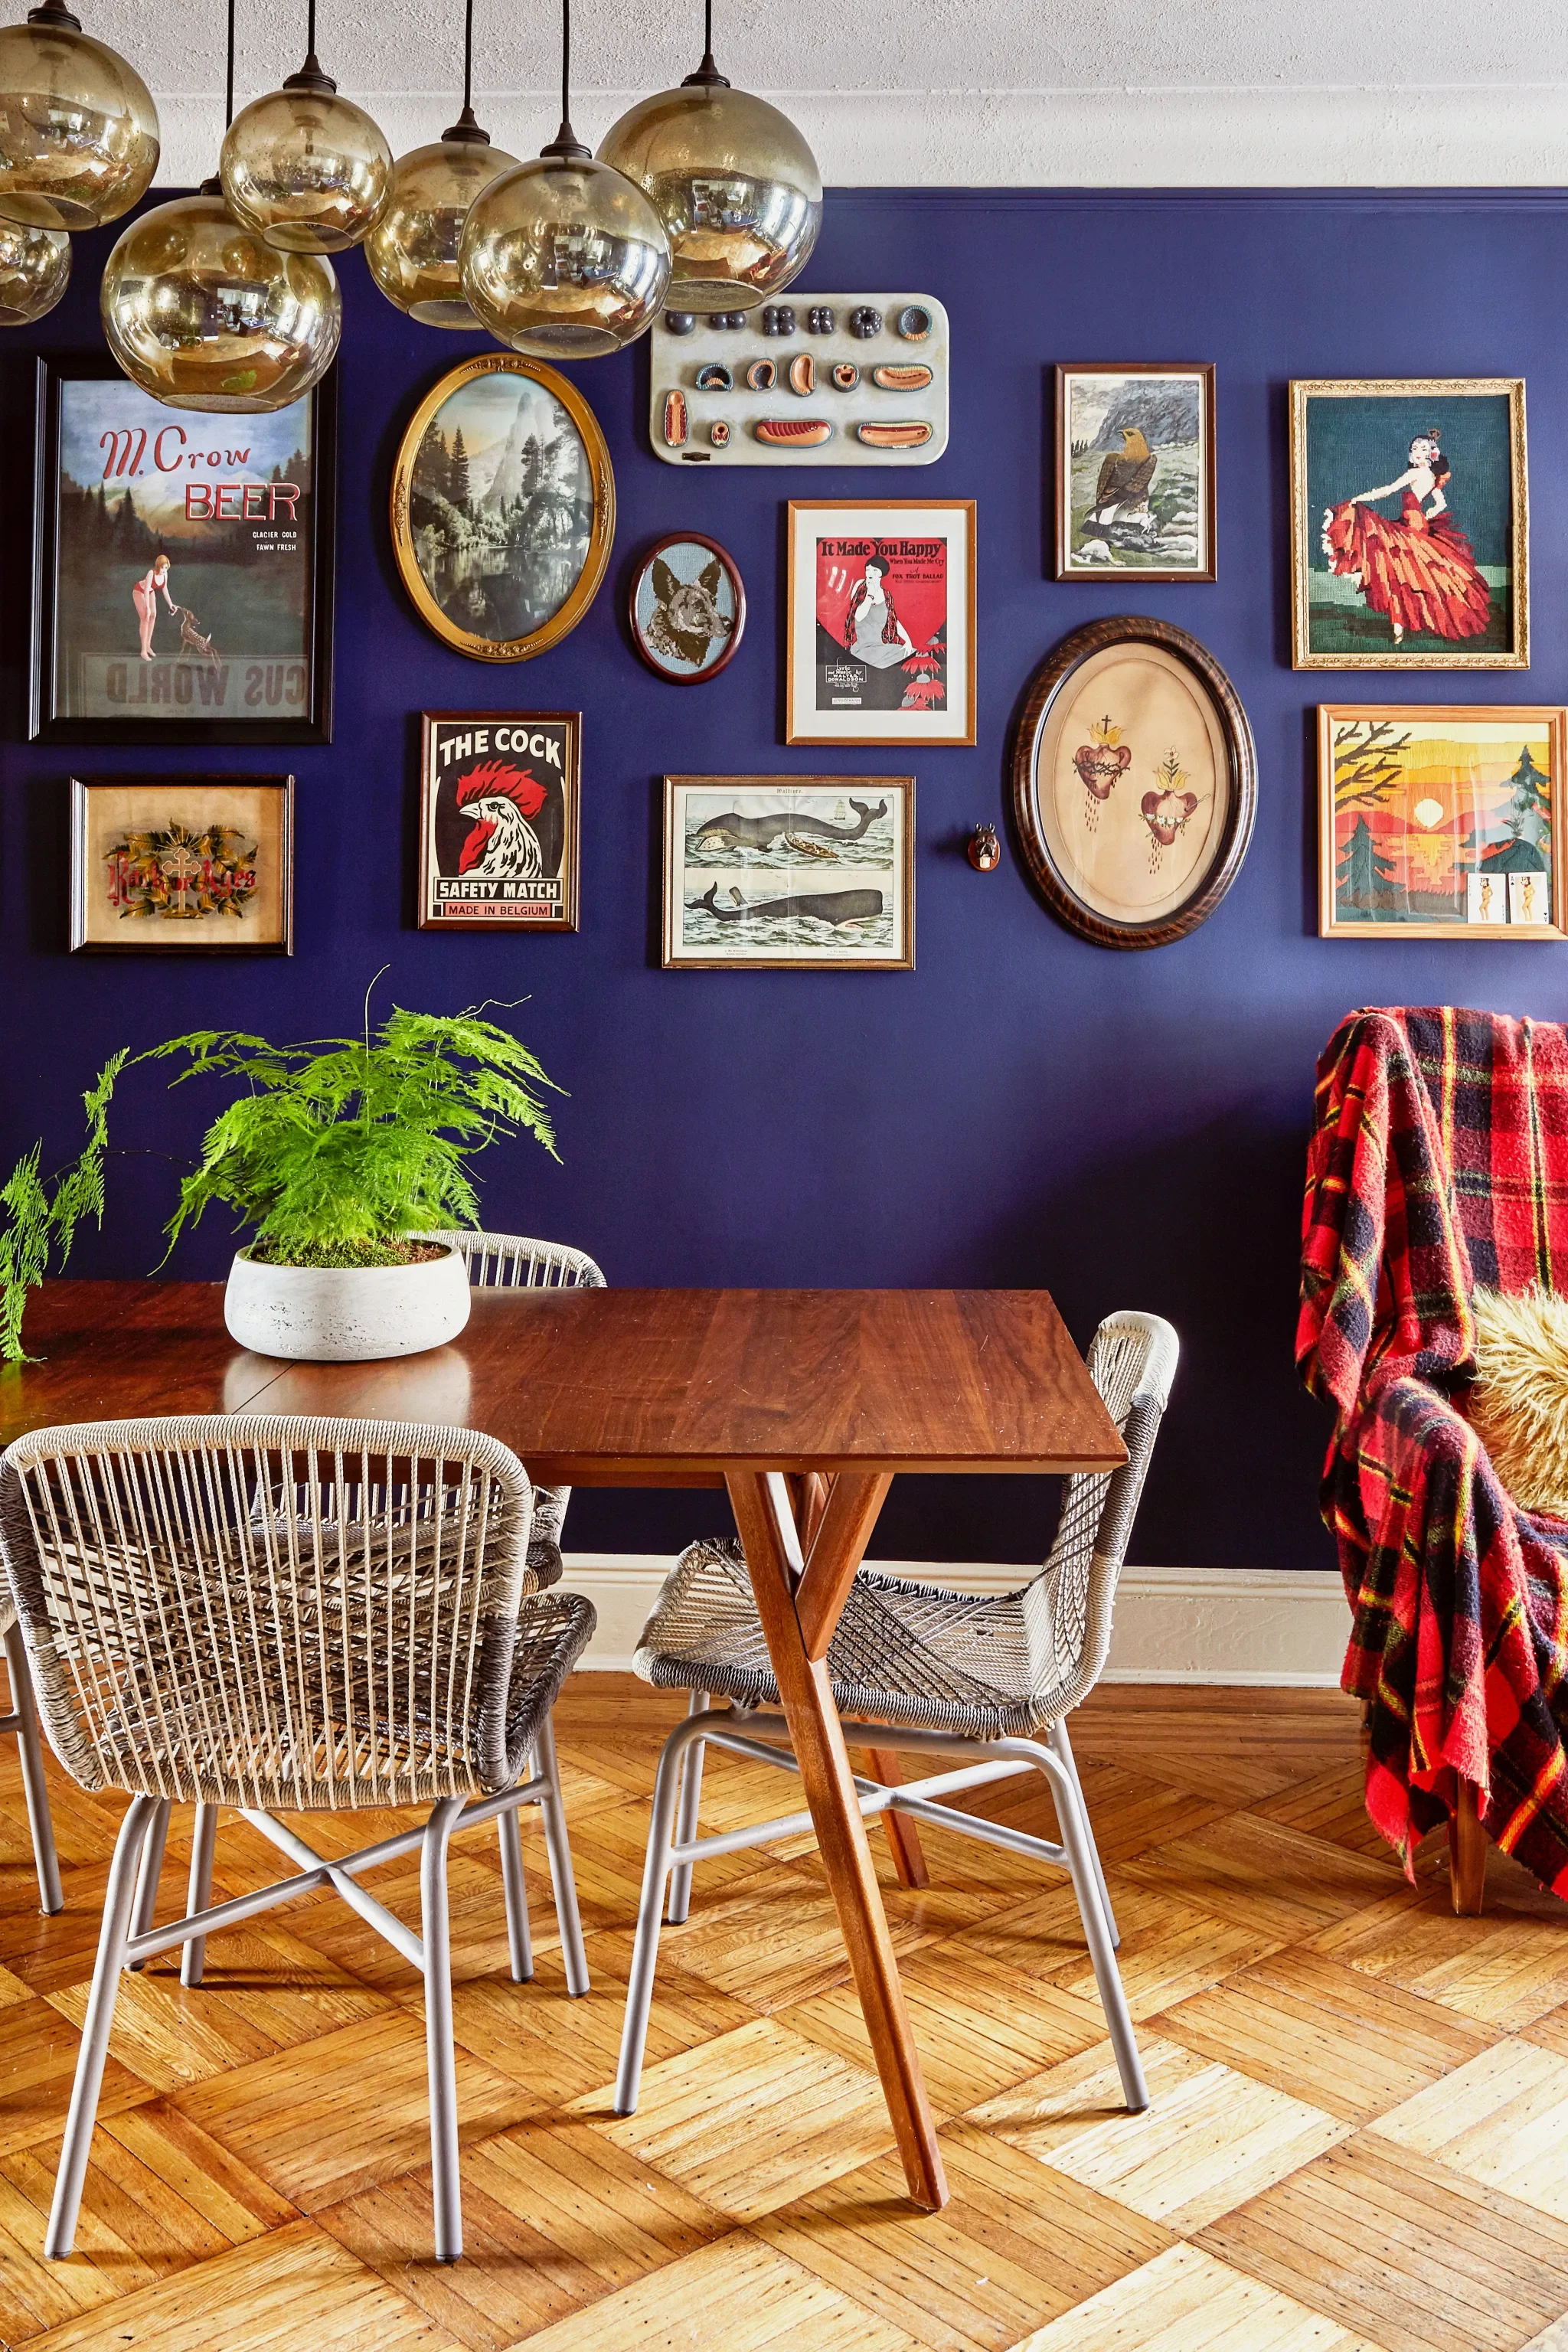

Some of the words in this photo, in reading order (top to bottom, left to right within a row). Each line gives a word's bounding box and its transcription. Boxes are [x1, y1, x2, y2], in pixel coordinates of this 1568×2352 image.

[154, 425, 251, 472] Crow
[185, 482, 301, 521] BEER
[822, 541, 834, 556] It
[837, 541, 871, 556] Made
[871, 541, 898, 556] You
[899, 541, 942, 558] Happy
[935, 558, 945, 567] Cry
[439, 730, 489, 767] THE
[495, 728, 562, 770] COCK
[439, 882, 498, 898] SAFETY
[503, 883, 557, 899] MATCH
[449, 906, 479, 915] MADE
[485, 906, 495, 915] IN
[500, 906, 547, 916] BELGIUM
